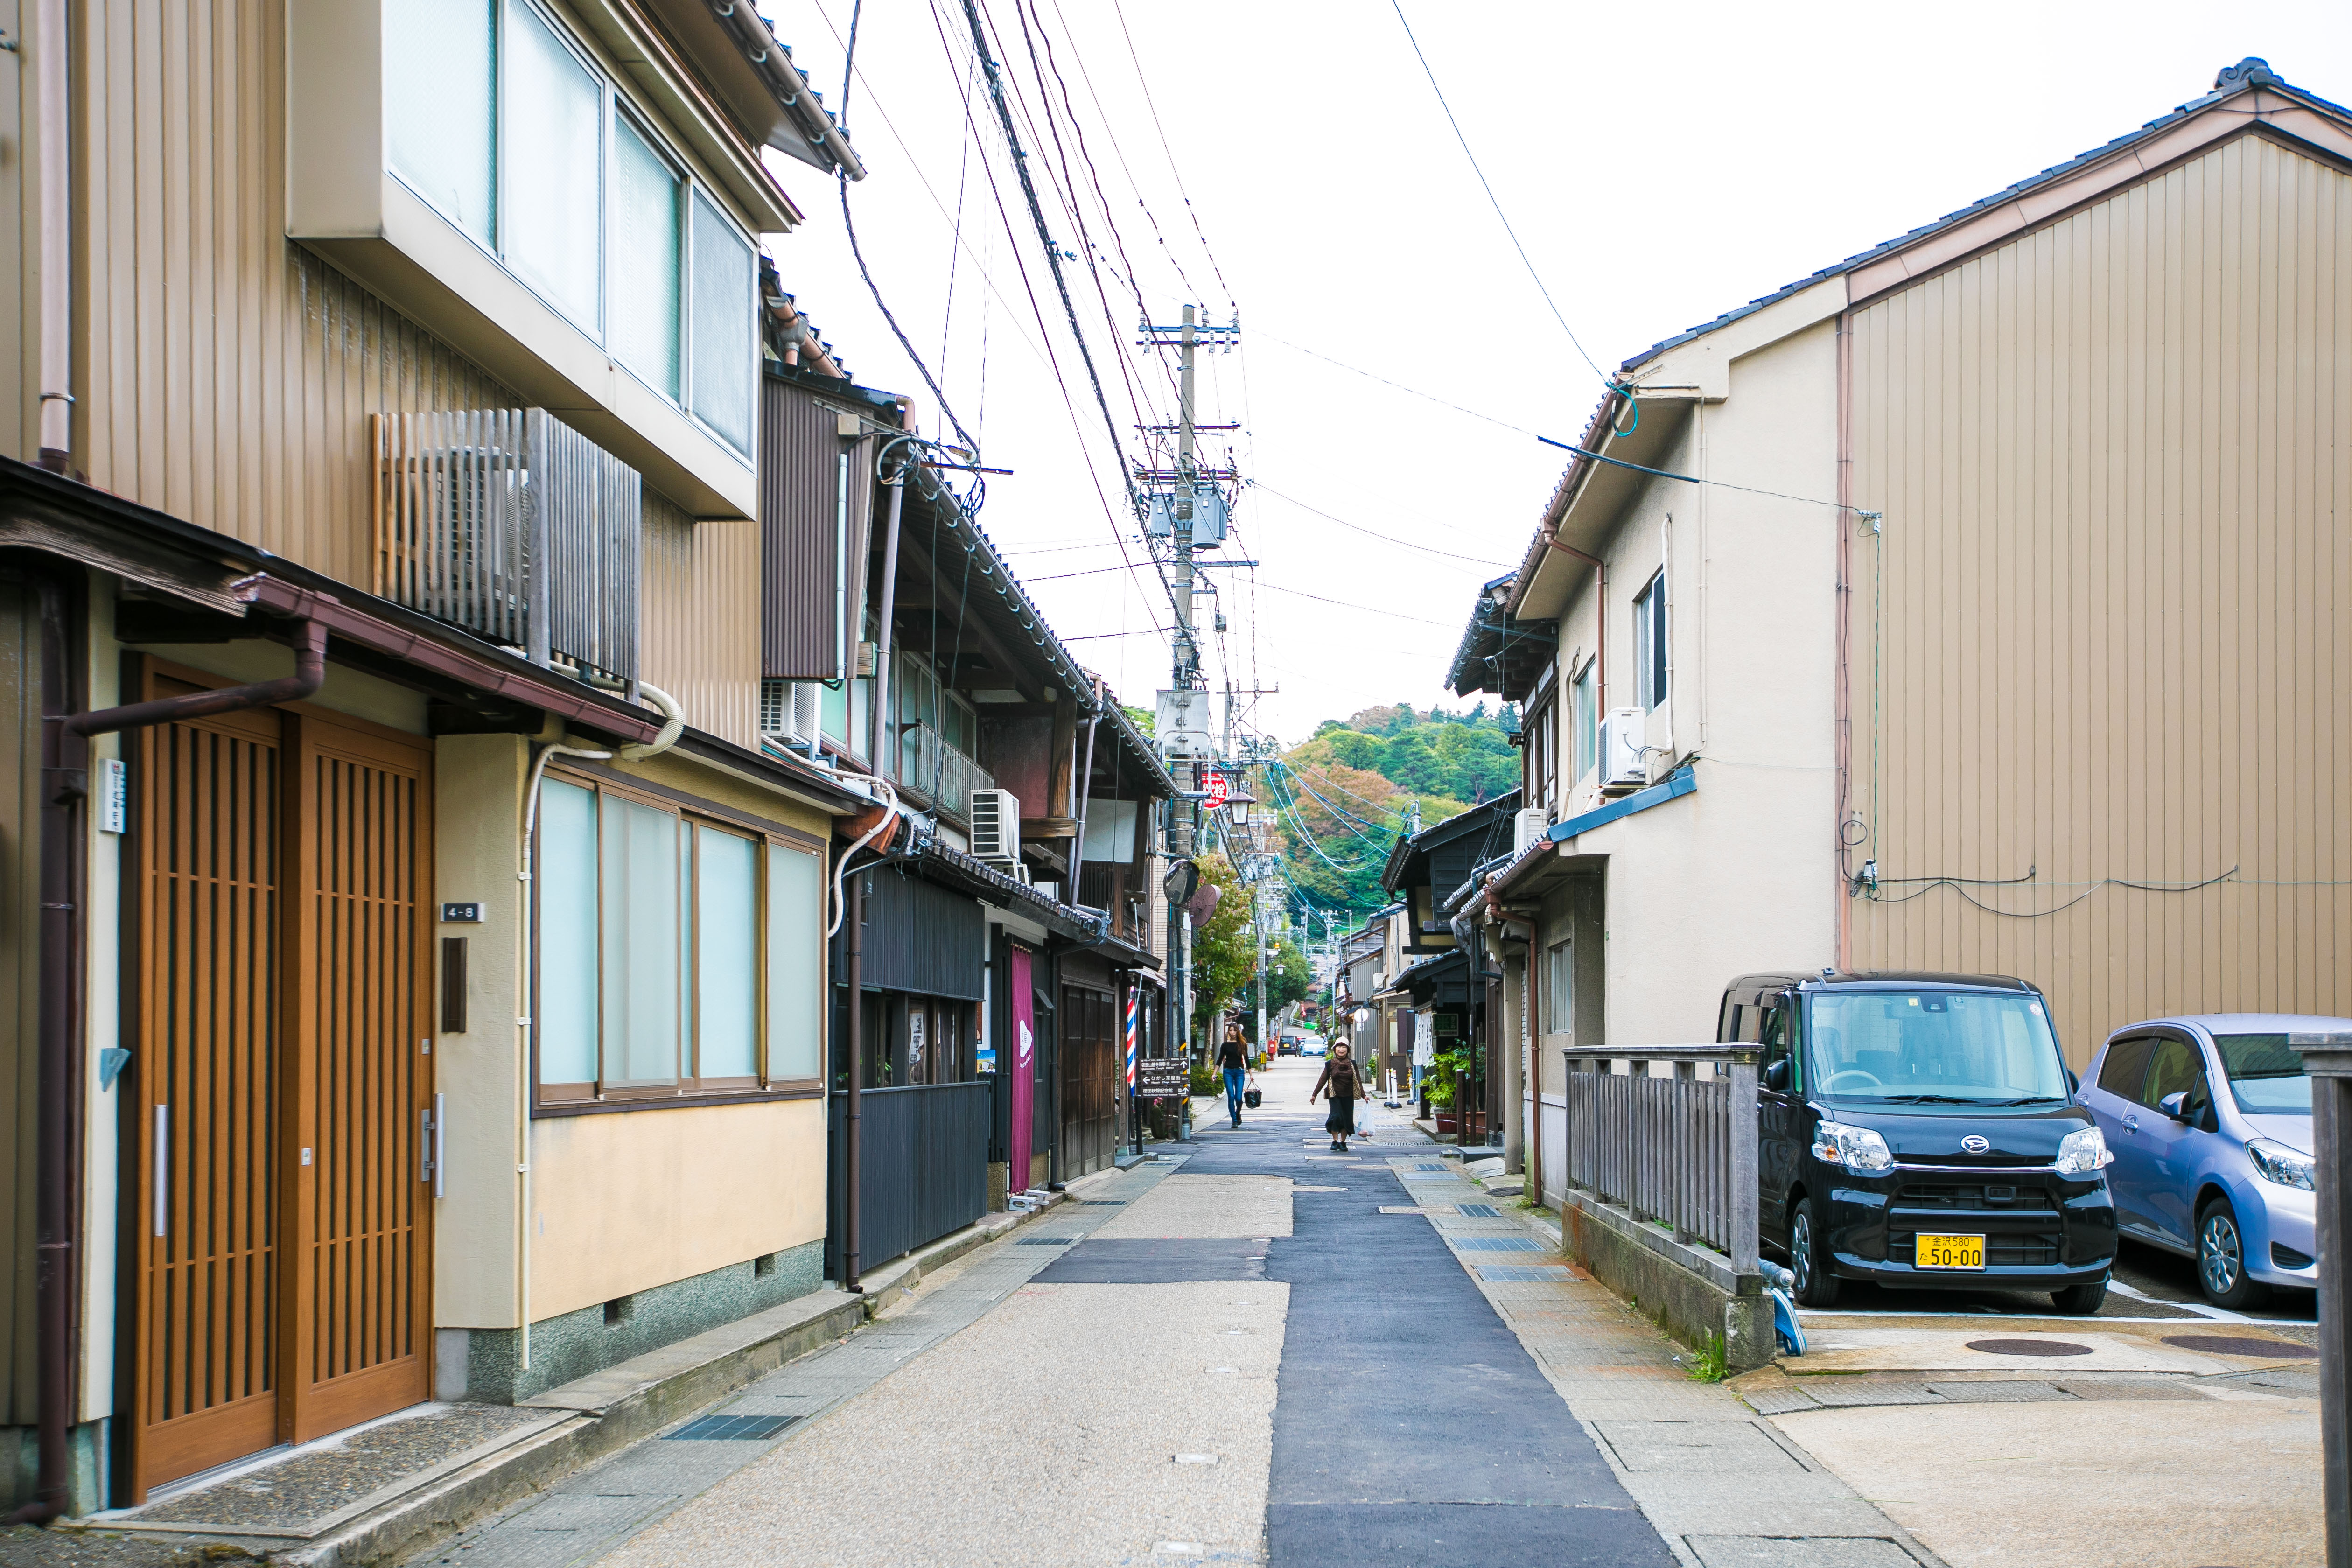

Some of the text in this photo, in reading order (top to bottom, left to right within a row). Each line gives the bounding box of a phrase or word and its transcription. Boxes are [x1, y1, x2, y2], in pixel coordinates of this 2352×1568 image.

[1155, 520, 1164, 529] 10
[448, 907, 474, 917] 4-8
[1931, 1248, 1981, 1266] 50-00
